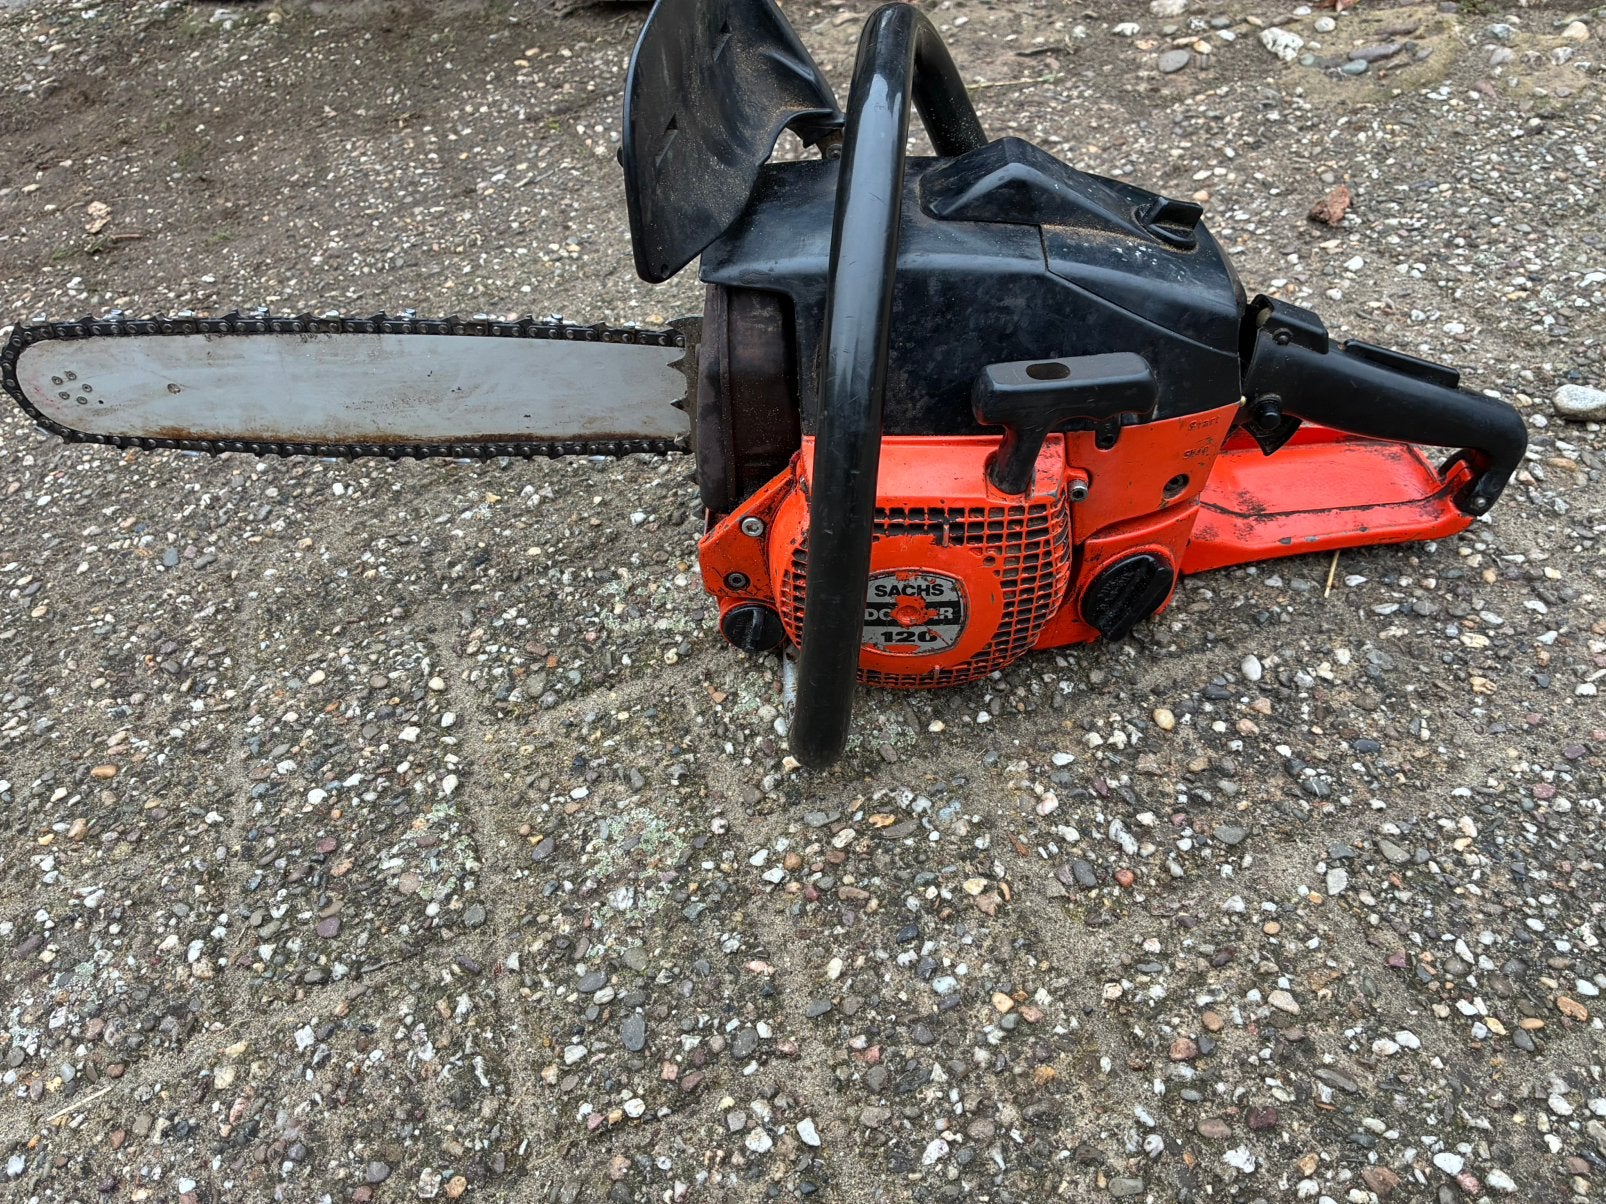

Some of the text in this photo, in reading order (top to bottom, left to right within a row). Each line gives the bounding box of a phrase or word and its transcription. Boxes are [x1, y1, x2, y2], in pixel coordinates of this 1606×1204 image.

[874, 584, 944, 597] SACHS
[864, 607, 954, 620] DOR
[880, 630, 938, 642] 120
